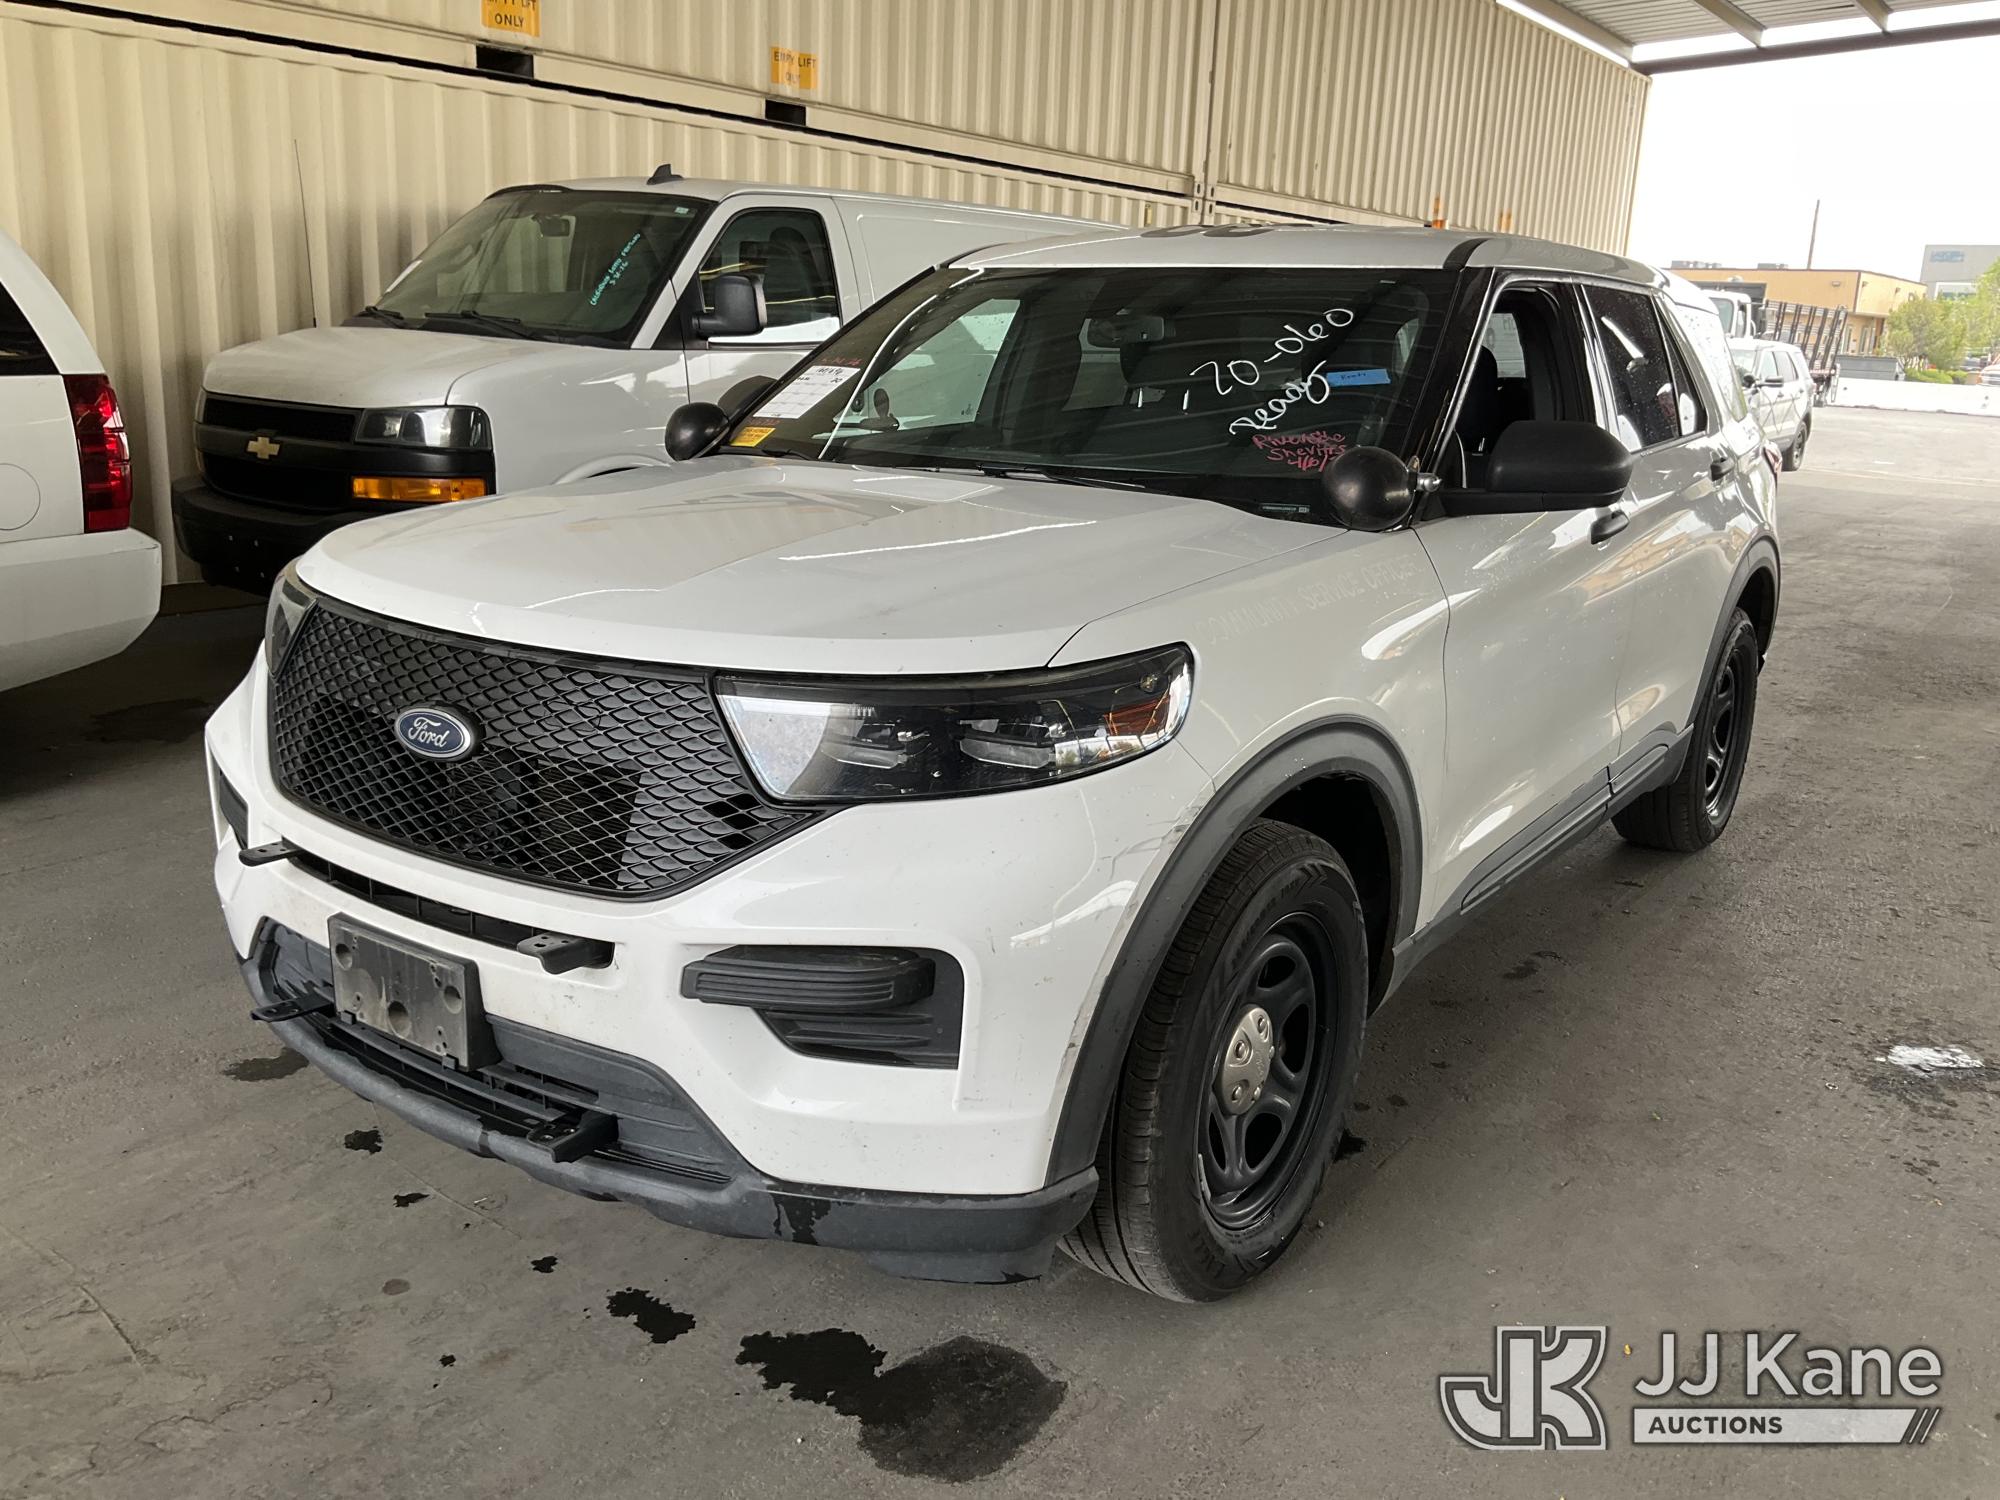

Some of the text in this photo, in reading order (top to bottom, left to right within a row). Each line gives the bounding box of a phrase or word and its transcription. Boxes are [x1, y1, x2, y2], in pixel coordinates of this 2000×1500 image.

[494, 13, 524, 28] ONLY
[797, 57, 817, 69] LIFT
[407, 716, 450, 748] Ford
